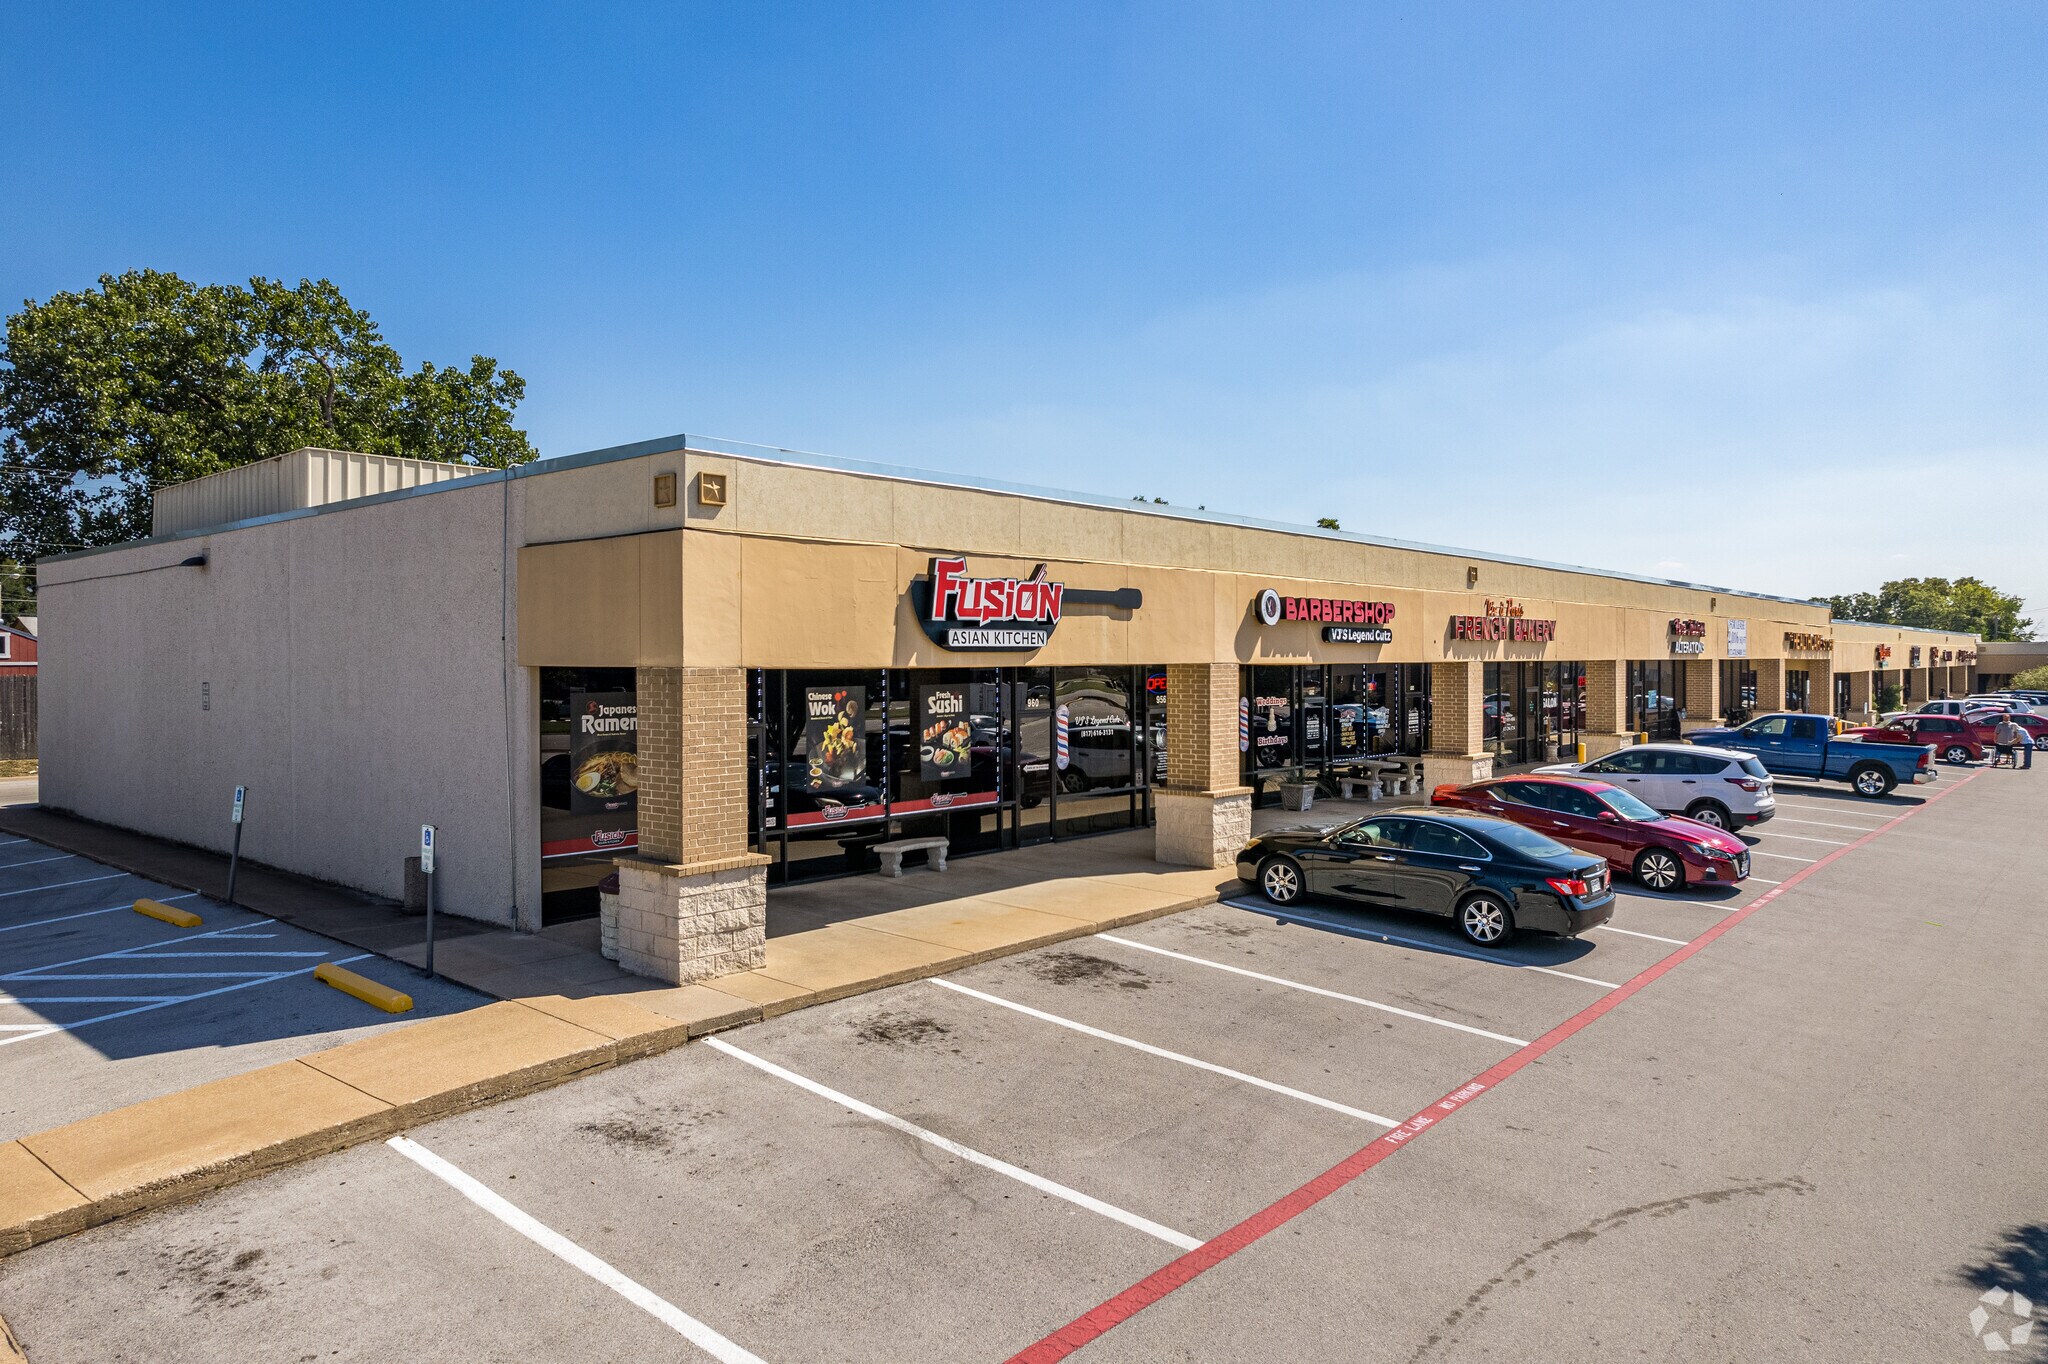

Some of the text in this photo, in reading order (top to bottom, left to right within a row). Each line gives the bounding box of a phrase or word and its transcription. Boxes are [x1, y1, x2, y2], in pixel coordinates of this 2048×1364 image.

[1285, 596, 1396, 624] BARBERSHOP
[1454, 615, 1557, 642] FRENCH BAKERY
[951, 631, 1045, 645] ASIAN KITCHEN
[1348, 629, 1375, 643] Legend
[1375, 629, 1392, 642] Cutz
[1675, 641, 1705, 654] ALTERATIONS
[1146, 677, 1167, 690] OPE
[808, 692, 833, 701] Chinese
[936, 691, 951, 700] Fresh
[1256, 696, 1288, 708] Weddings
[808, 701, 836, 716] Wok
[928, 694, 963, 714] Sushi
[1027, 698, 1040, 708] 960
[598, 704, 638, 717] Japanes
[581, 714, 638, 735] Ramen
[1257, 735, 1288, 747] Birthdays
[1384, 1082, 1486, 1144] FIRE LANE NO PARKING
